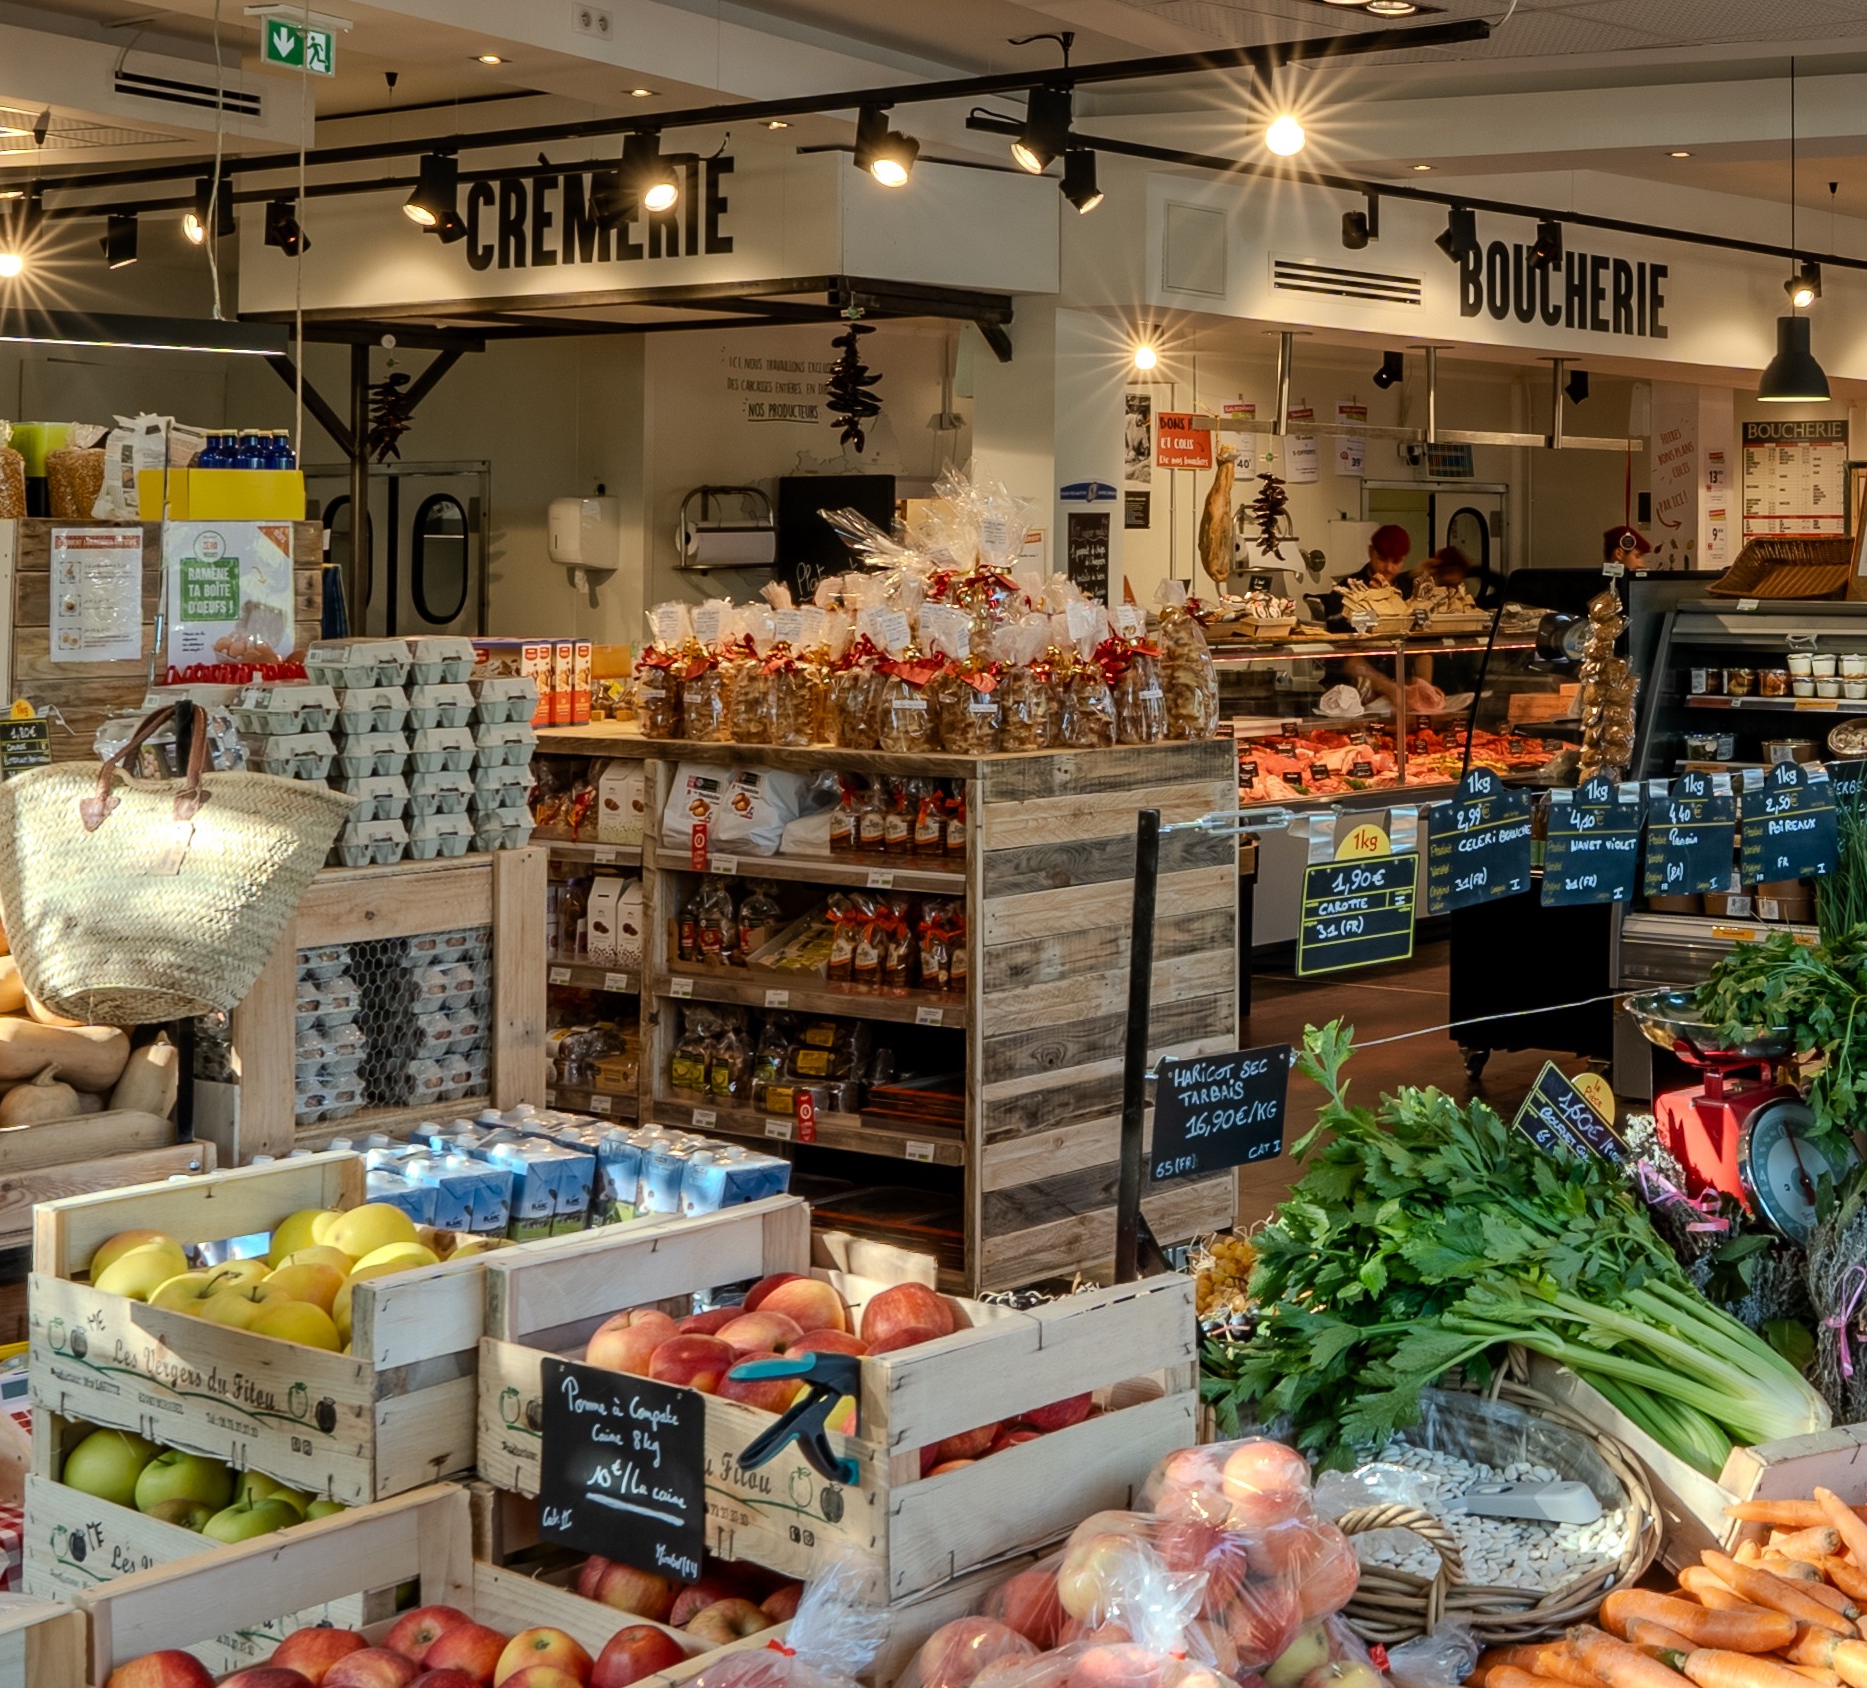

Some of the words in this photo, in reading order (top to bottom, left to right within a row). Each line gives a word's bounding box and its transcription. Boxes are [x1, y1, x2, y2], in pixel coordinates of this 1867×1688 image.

[1460, 240, 1668, 339] BOUCHERIE
[748, 403, 765, 417] NOS
[768, 403, 819, 419] PRODUCTEURS
[1748, 422, 1842, 439] BOUCHERIE
[188, 584, 202, 597] TA
[203, 583, 230, 597] BOÎTE
[1467, 772, 1491, 794] 1kg
[1776, 765, 1797, 785] 1kg
[1586, 783, 1608, 801] 1kg
[1684, 776, 1704, 796] 1kg
[1353, 830, 1379, 851] 1kg
[1570, 839, 1603, 852] NAVET
[1777, 856, 1789, 868] FR
[1332, 868, 1386, 895] 1,90€
[1318, 897, 1368, 915] CAROTTE
[1240, 1059, 1268, 1079] SEC
[1185, 1100, 1277, 1139] 16,90€/KG
[1248, 1143, 1270, 1159] CAT
[113, 1339, 138, 1369] Les
[143, 1346, 202, 1388] Vergers
[207, 1366, 228, 1394] du
[229, 1372, 275, 1412] Fitou
[561, 1376, 608, 1415] Pomme
[612, 1397, 624, 1417] à
